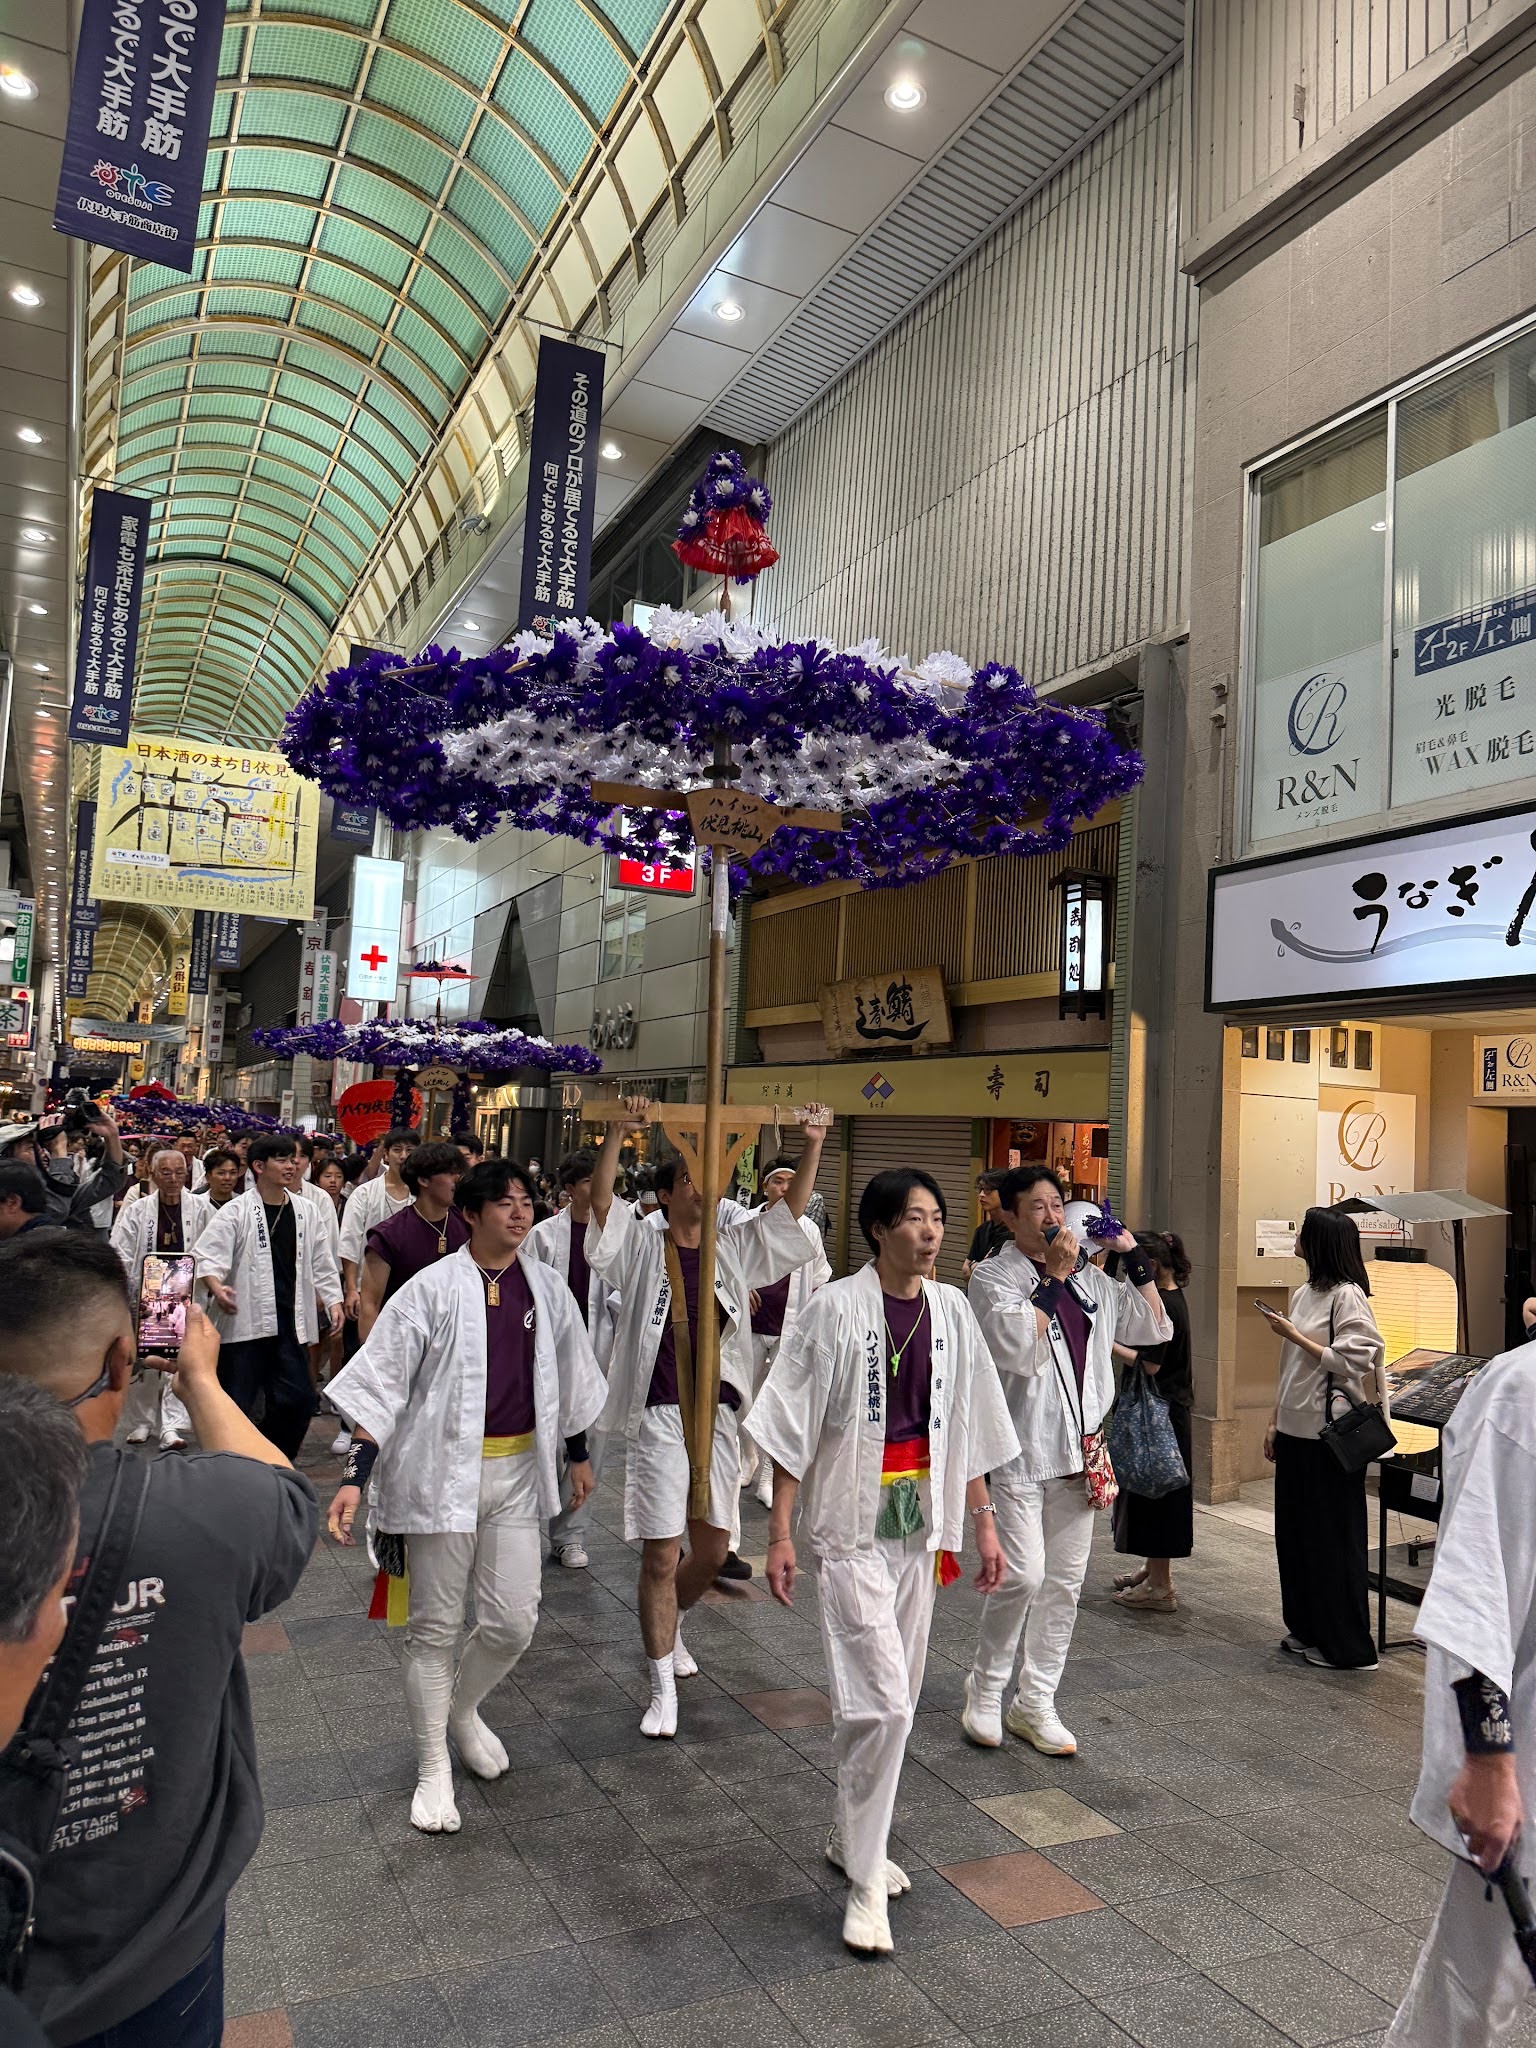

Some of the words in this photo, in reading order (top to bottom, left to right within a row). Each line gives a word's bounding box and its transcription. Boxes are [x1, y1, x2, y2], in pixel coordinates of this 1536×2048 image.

[77, 197, 179, 241] 伏見大手筋商店街
[556, 372, 590, 610] その道のプロが居てるで大手筋
[534, 461, 560, 603] 何でもあるで大手筋
[103, 515, 139, 700] 家電も茶店もあるで大手筋
[84, 585, 109, 696] 何でもあるで大手筋
[1446, 640, 1469, 660] 2F
[1472, 612, 1532, 652] 左側
[1433, 675, 1516, 720] 光脱毛
[1416, 730, 1469, 755] 眉毛&鼻毛
[1275, 758, 1361, 811] R&N
[709, 797, 759, 816] ハイツ
[1296, 803, 1339, 820] メンズ脱毛
[699, 813, 763, 843] 伏見桃山
[641, 865, 673, 885] 3F
[1352, 856, 1503, 954] うなぎ
[13, 914, 31, 980] お部屋探し!
[173, 957, 186, 993] 3番街
[141, 1003, 151, 1024] 4番
[209, 1005, 223, 1059] 京都銀行
[866, 1329, 881, 1423] ハイツ伏見桃山
[77, 1714, 98, 1728] San
[99, 1708, 127, 1723] Diego
[128, 1702, 142, 1714] CA
[80, 1691, 129, 1710] Columbus
[136, 1716, 147, 1728] IN
[81, 1746, 104, 1760] New
[105, 1738, 127, 1753] York
[84, 1763, 101, 1776] Los
[102, 1752, 141, 1770] Angeles
[142, 1747, 155, 1759] CA
[84, 1779, 106, 1792] New
[107, 1772, 130, 1786] York
[82, 1793, 117, 1808] Detroit
[71, 1811, 118, 1834] STARS
[84, 1821, 119, 1842] GRIN
